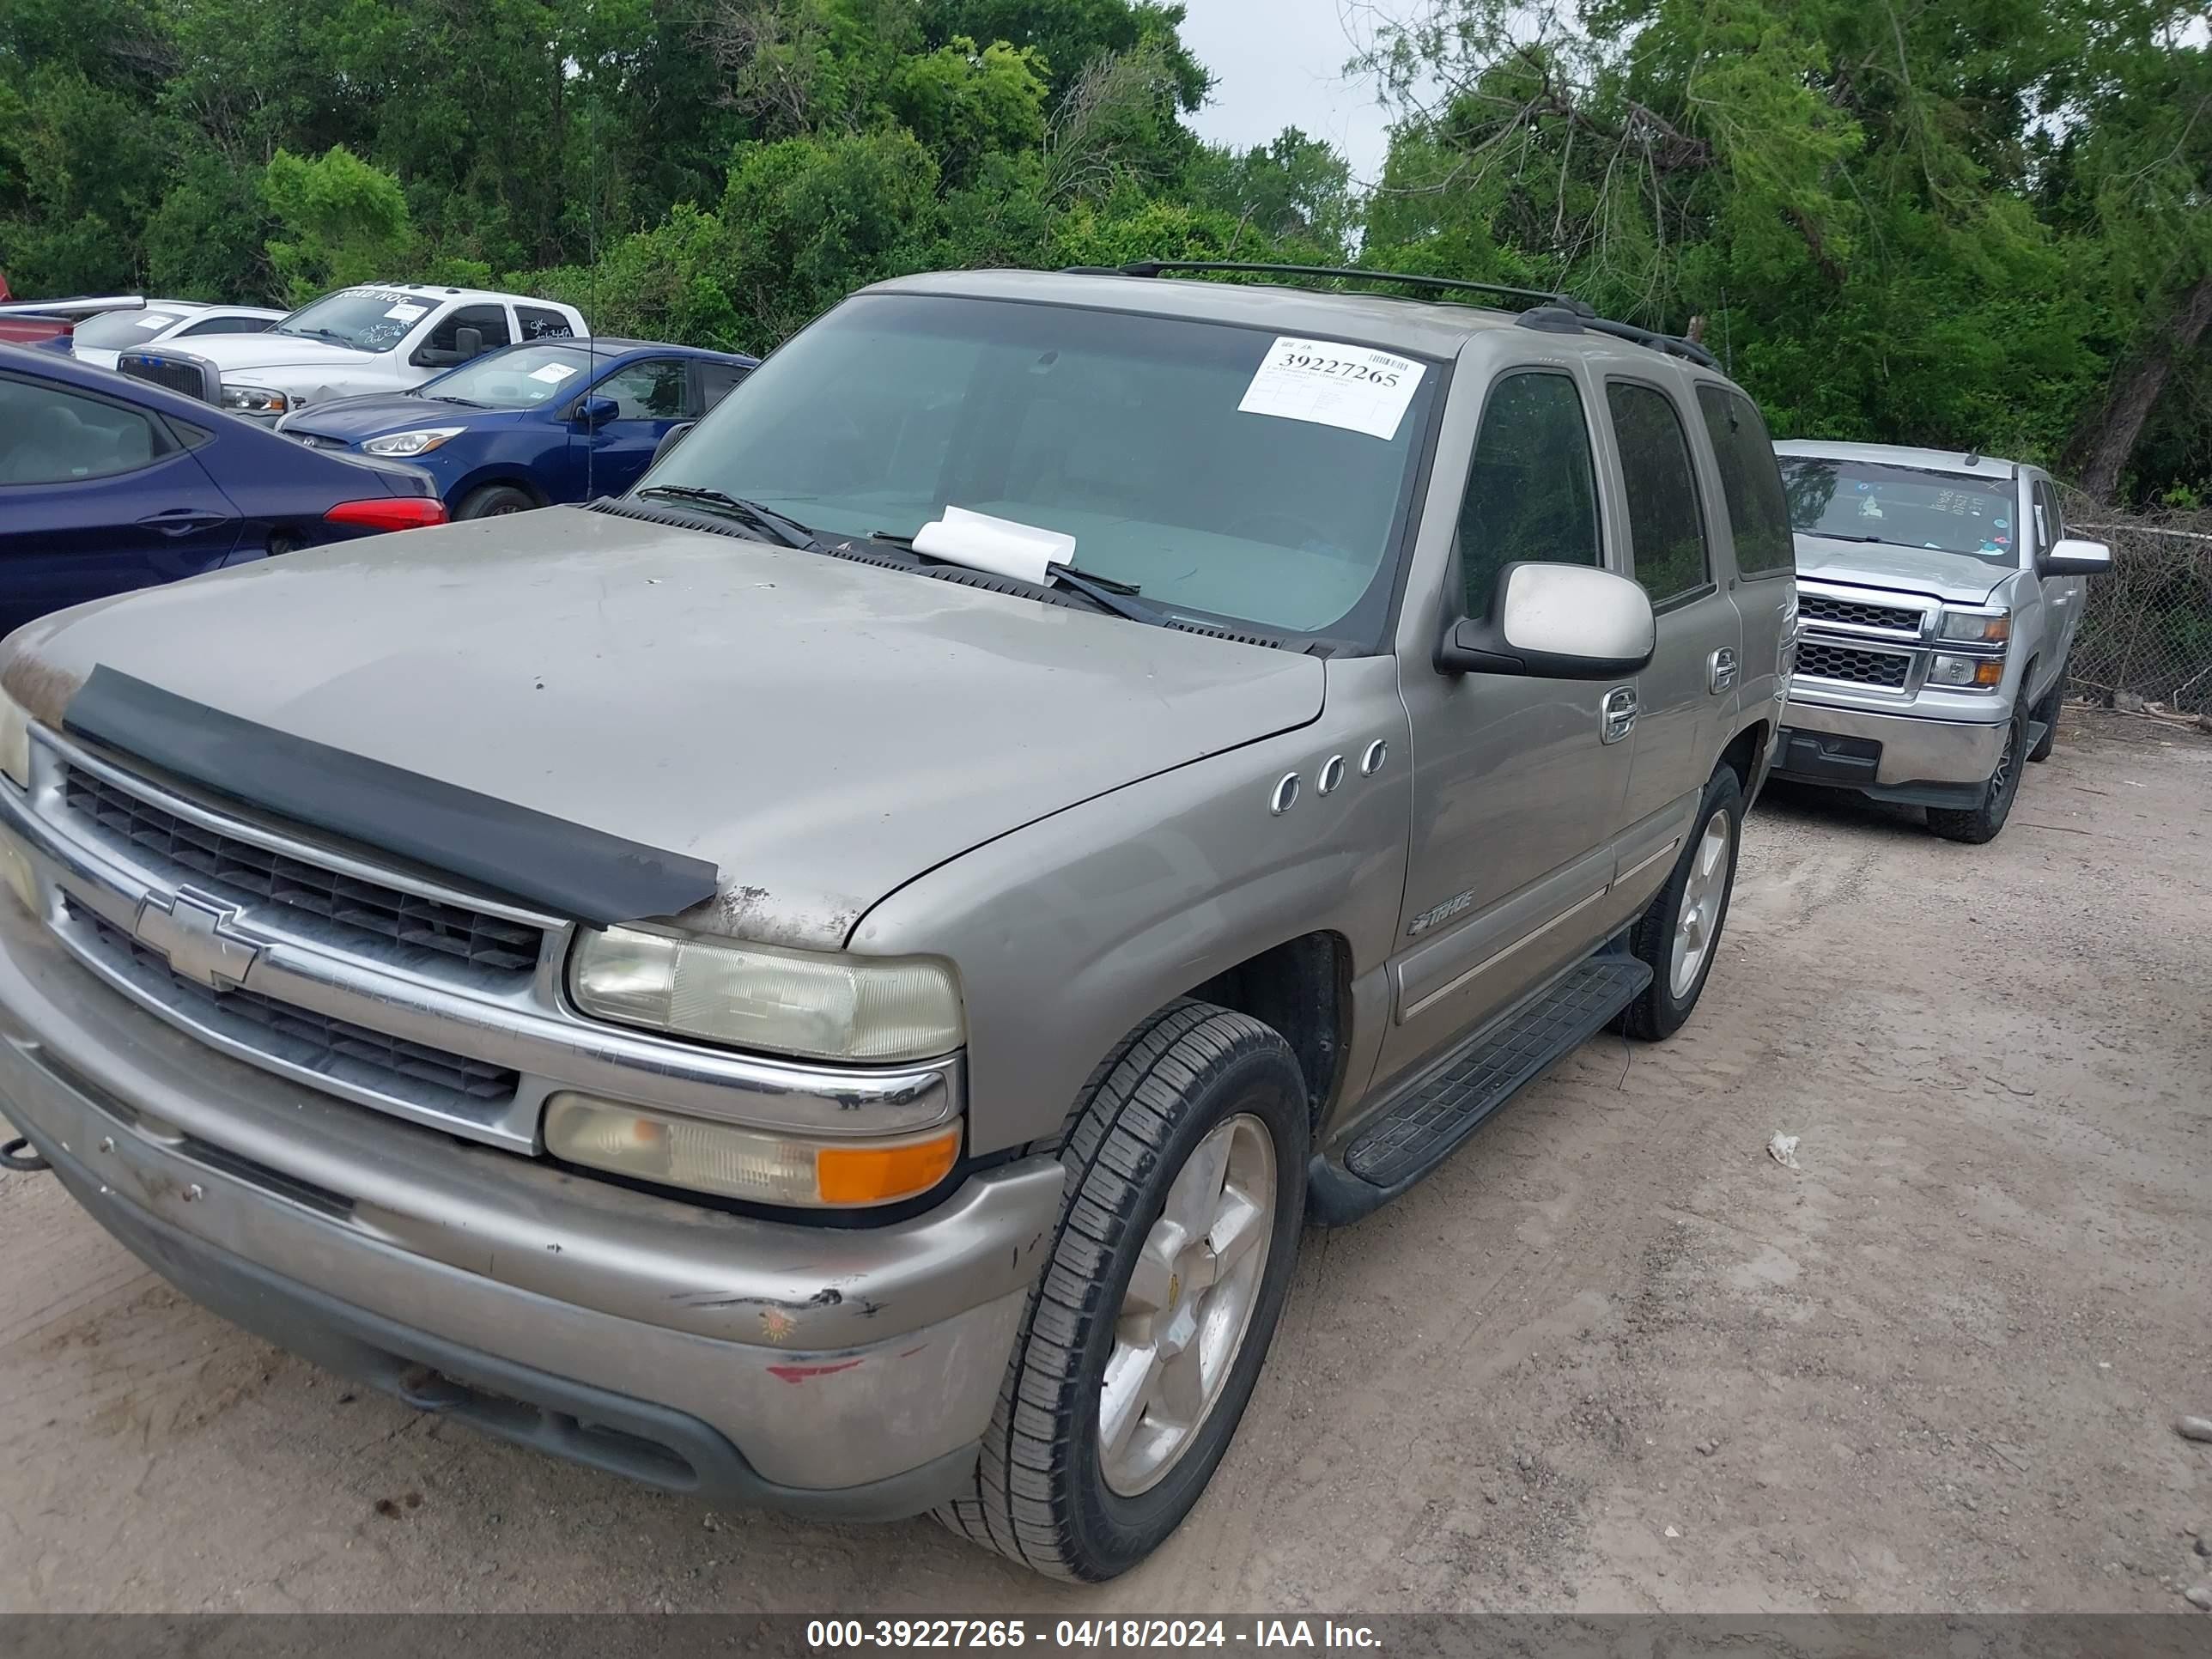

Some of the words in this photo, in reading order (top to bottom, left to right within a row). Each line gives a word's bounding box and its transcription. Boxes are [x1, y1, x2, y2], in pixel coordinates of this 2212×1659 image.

[334, 290, 375, 299] ROAD
[374, 292, 413, 304] HOG
[1278, 353, 1400, 388] 39227265
